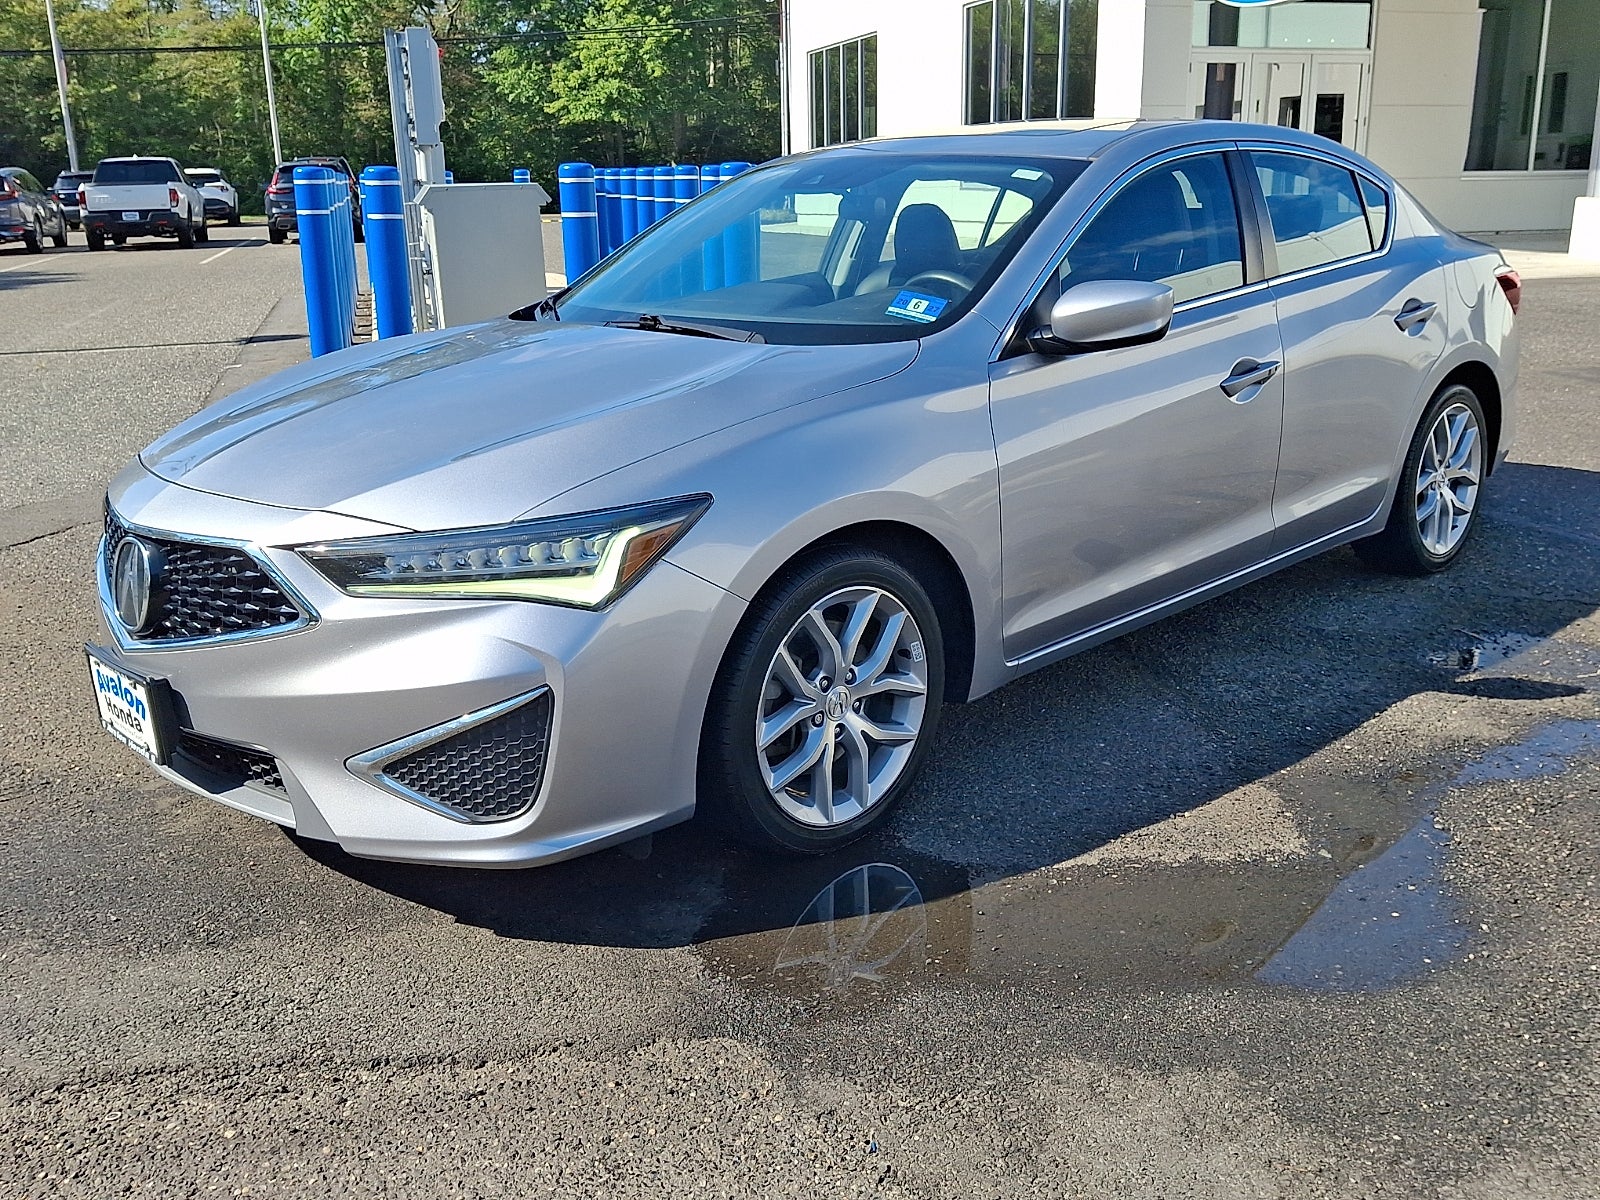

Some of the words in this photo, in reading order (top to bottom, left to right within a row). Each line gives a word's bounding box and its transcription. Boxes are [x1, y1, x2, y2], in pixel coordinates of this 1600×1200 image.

[913, 300, 922, 310] 6
[96, 668, 146, 721] Avalon
[104, 694, 143, 734] Honda
